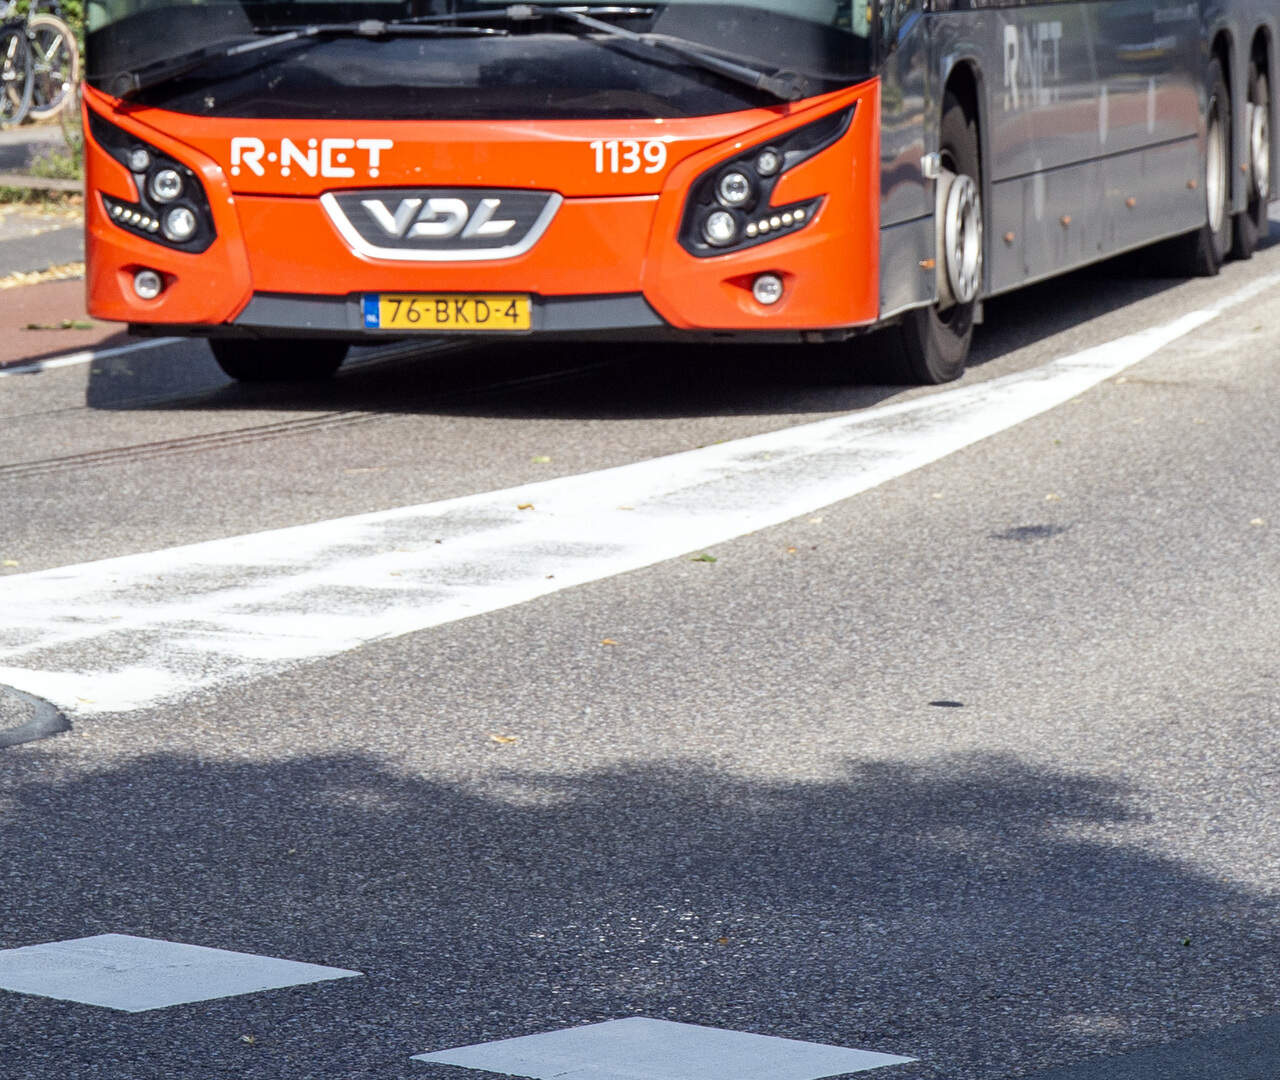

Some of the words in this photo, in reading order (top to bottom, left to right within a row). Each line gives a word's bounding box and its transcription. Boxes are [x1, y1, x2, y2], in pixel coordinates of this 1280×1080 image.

[590, 140, 667, 174] 1139
[361, 197, 517, 239] VDL
[387, 298, 520, 324] 76-BKD-4
